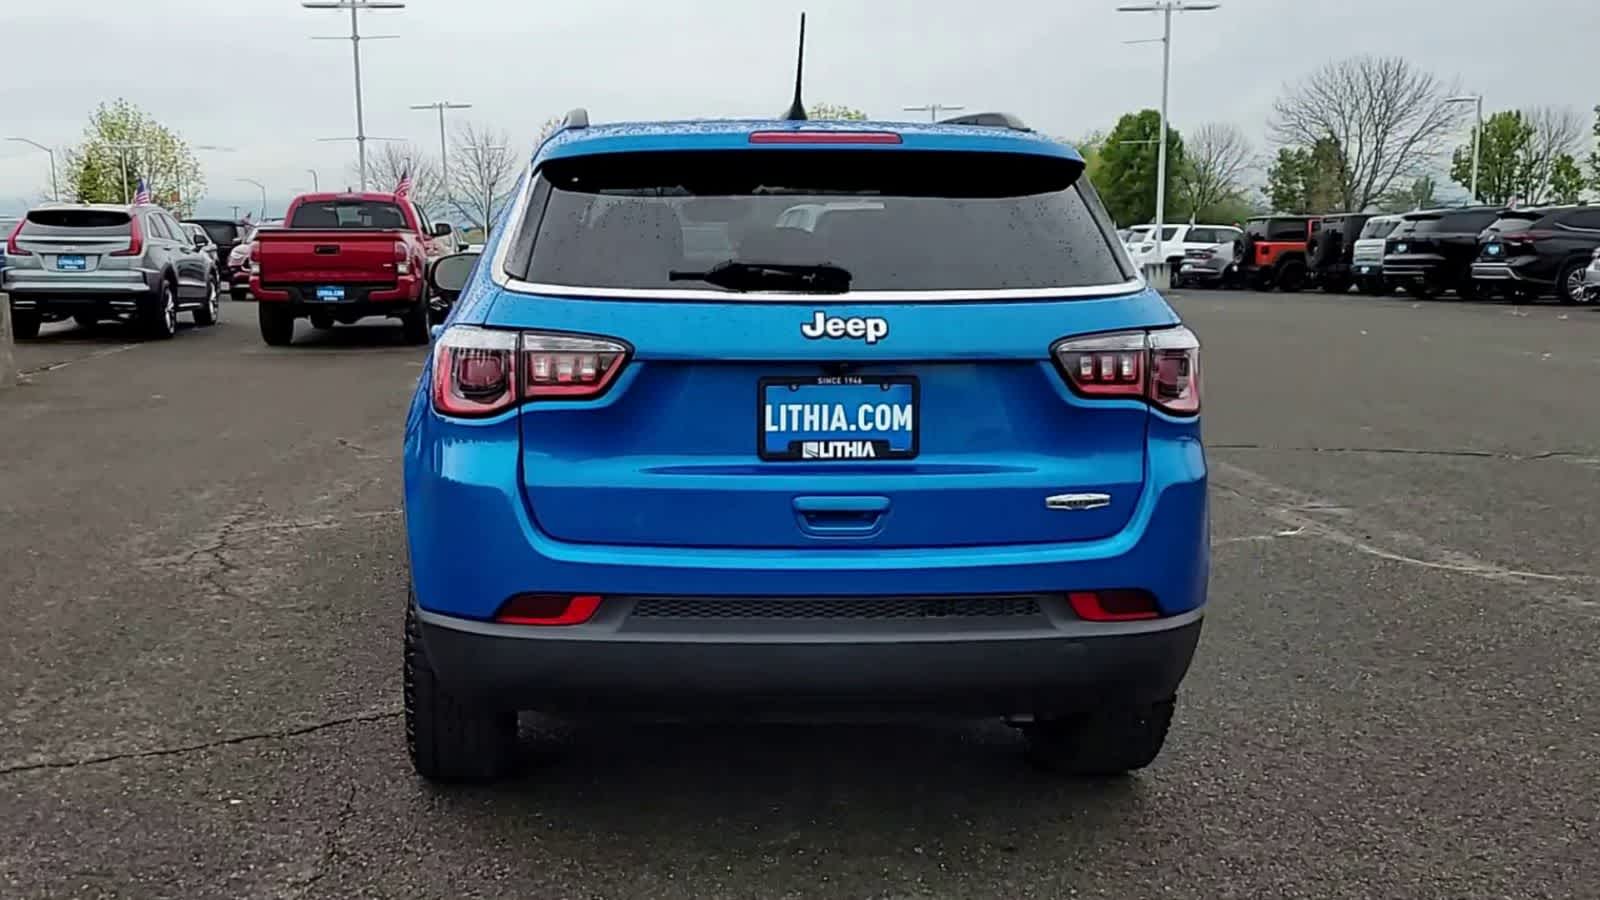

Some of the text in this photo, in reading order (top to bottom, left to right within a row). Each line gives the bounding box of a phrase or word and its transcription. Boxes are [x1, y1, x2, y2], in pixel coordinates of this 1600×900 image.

[801, 311, 889, 343] Jeep
[817, 376, 841, 384] SINCE
[764, 404, 913, 433] LITHIA.COM
[820, 441, 876, 459] LITHIA
